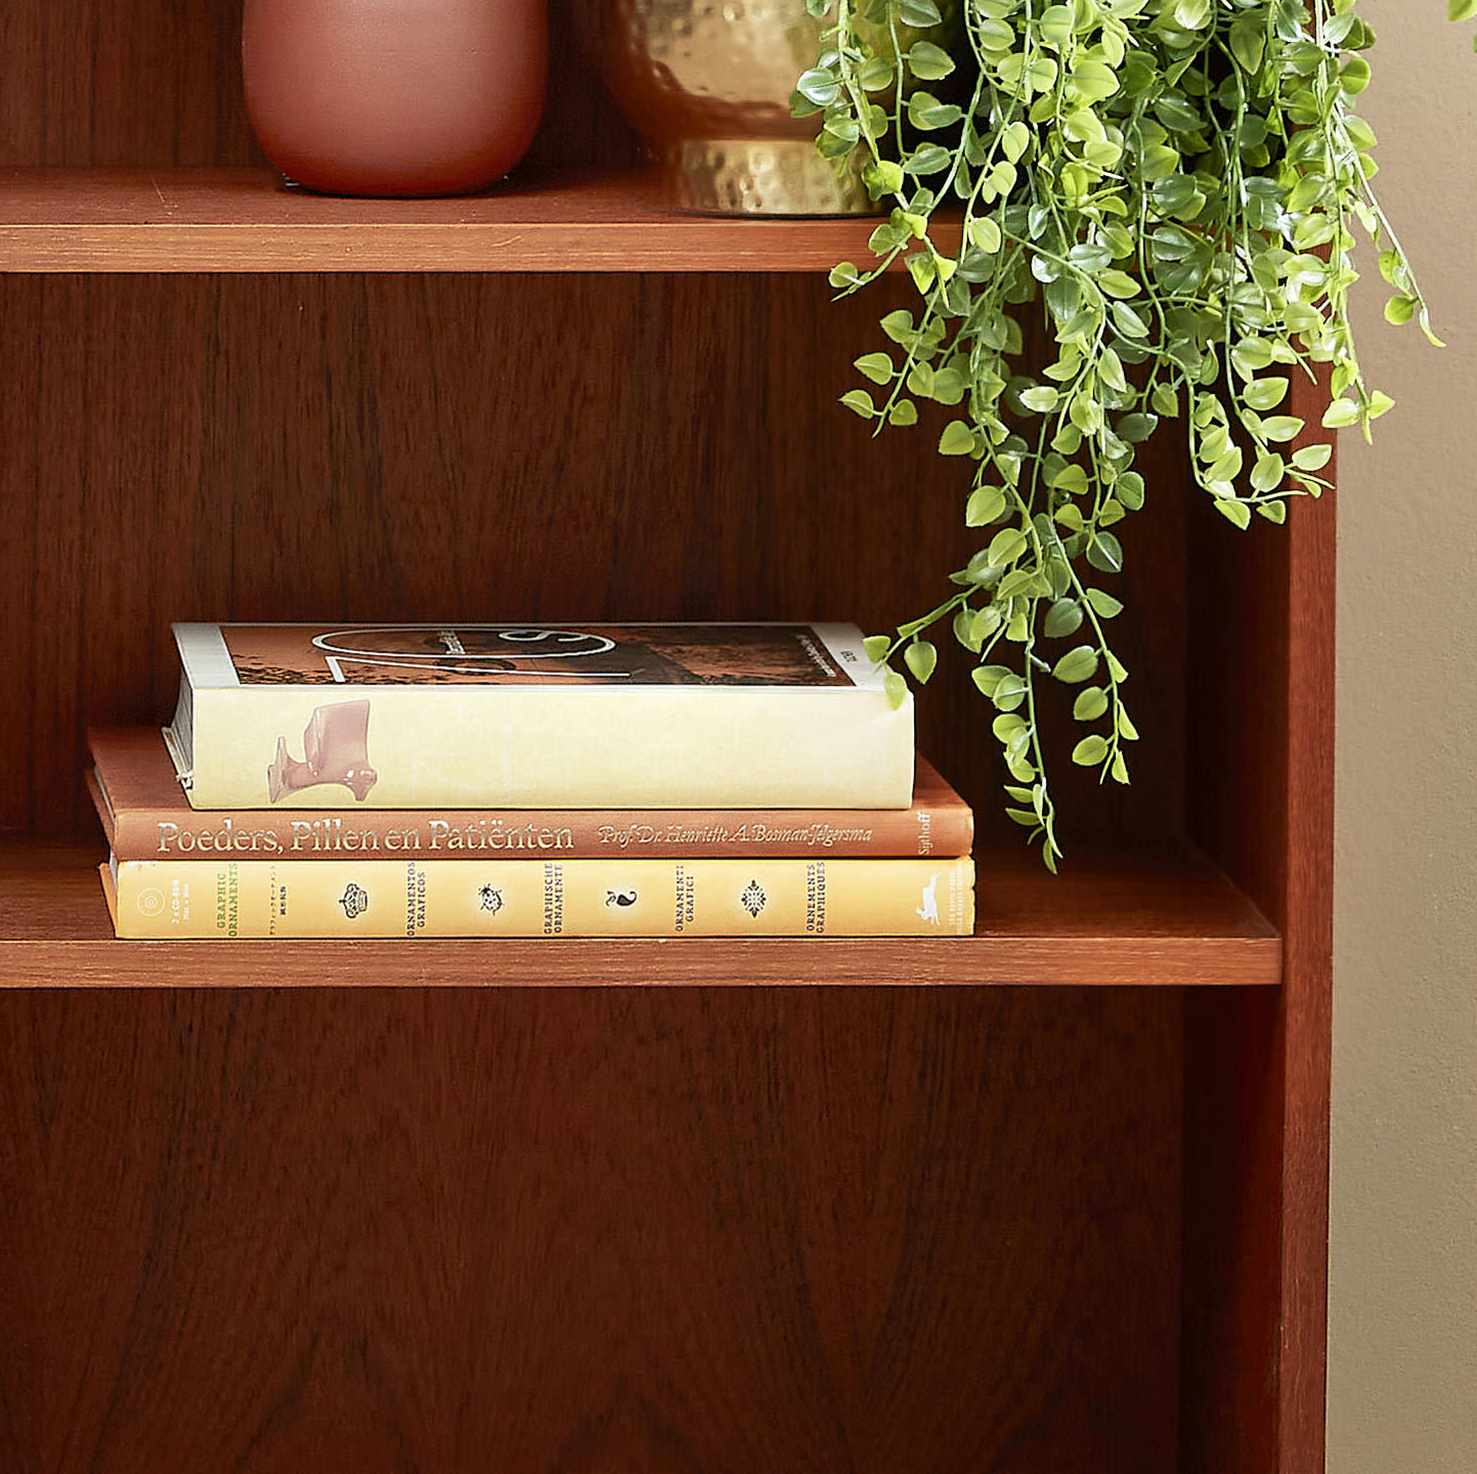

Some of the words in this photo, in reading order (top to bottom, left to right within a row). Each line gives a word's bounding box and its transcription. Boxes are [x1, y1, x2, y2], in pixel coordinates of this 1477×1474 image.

[157, 817, 284, 854] Poeders,
[290, 817, 380, 851] Pillen
[384, 828, 421, 850] en
[428, 819, 574, 850] Patiënten
[597, 824, 636, 849] Prof.
[636, 825, 662, 843] Dr.
[665, 825, 728, 843] Henriette
[752, 824, 873, 847] Bosman-Jelgersma
[917, 811, 933, 855] Sijthoff
[217, 873, 226, 929] GRAPHIC
[228, 862, 238, 937] ORNAMENTS
[407, 861, 416, 937] ORNAMENTOS
[544, 862, 553, 935] GRAPHISCHE
[554, 864, 563, 933] ORNAMENTE
[675, 865, 684, 932] ORNAMENTI
[686, 875, 694, 922] GRAFICI
[806, 864, 815, 931] ORNEMENTS
[816, 861, 825, 933] GRAPHIQUES
